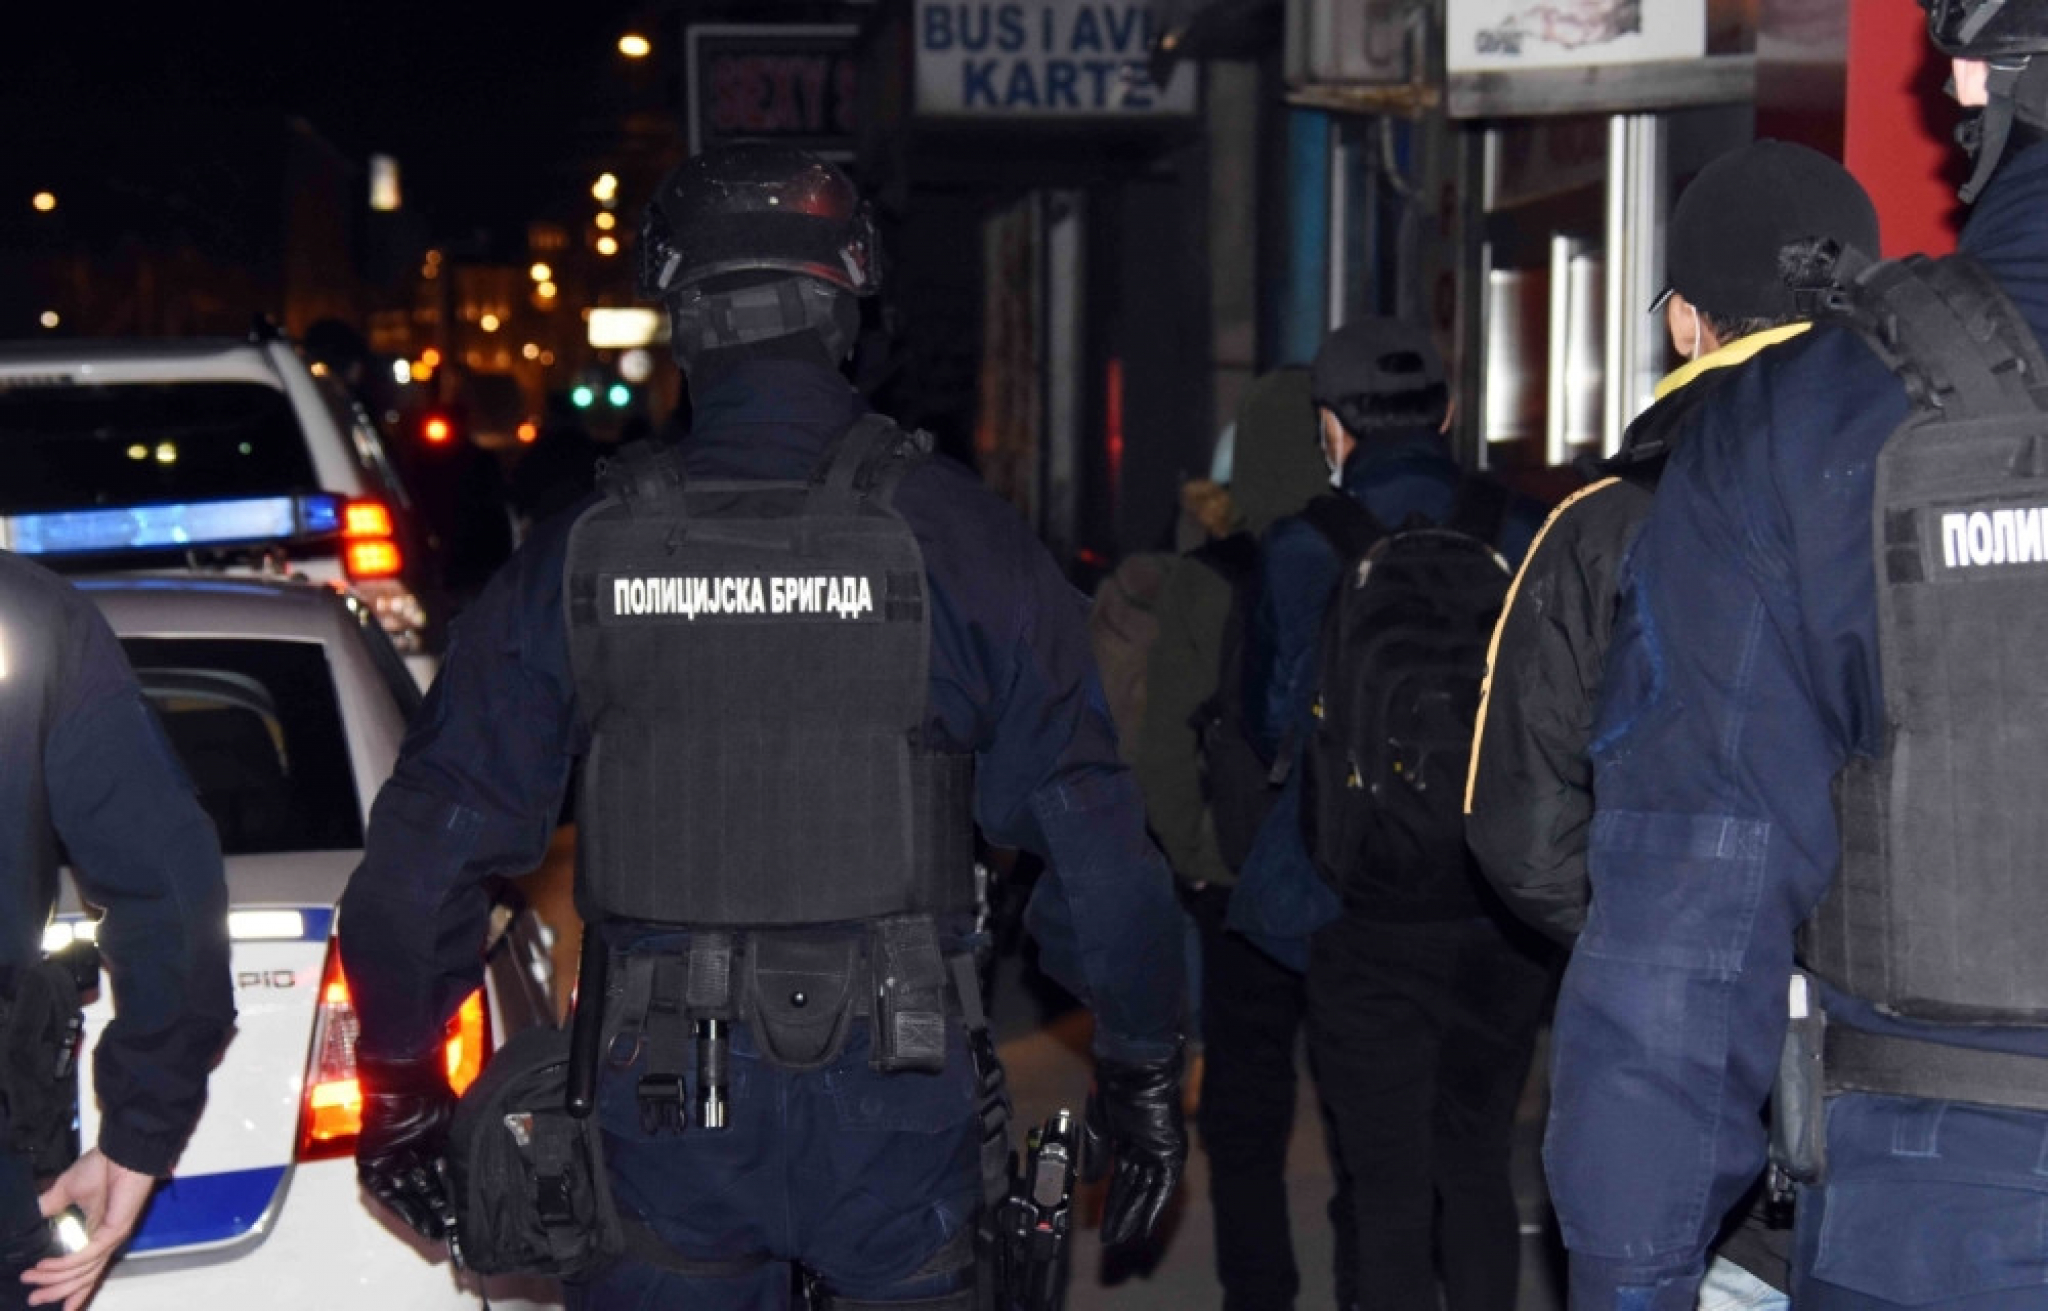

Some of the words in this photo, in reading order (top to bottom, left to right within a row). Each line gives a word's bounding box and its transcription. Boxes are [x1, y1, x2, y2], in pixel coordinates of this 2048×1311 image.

[924, 5, 1025, 51] BUS
[964, 59, 1153, 106] KARTE
[614, 576, 767, 621] ПОЛИЦИЈСКА
[769, 576, 874, 620] БРИГАДА
